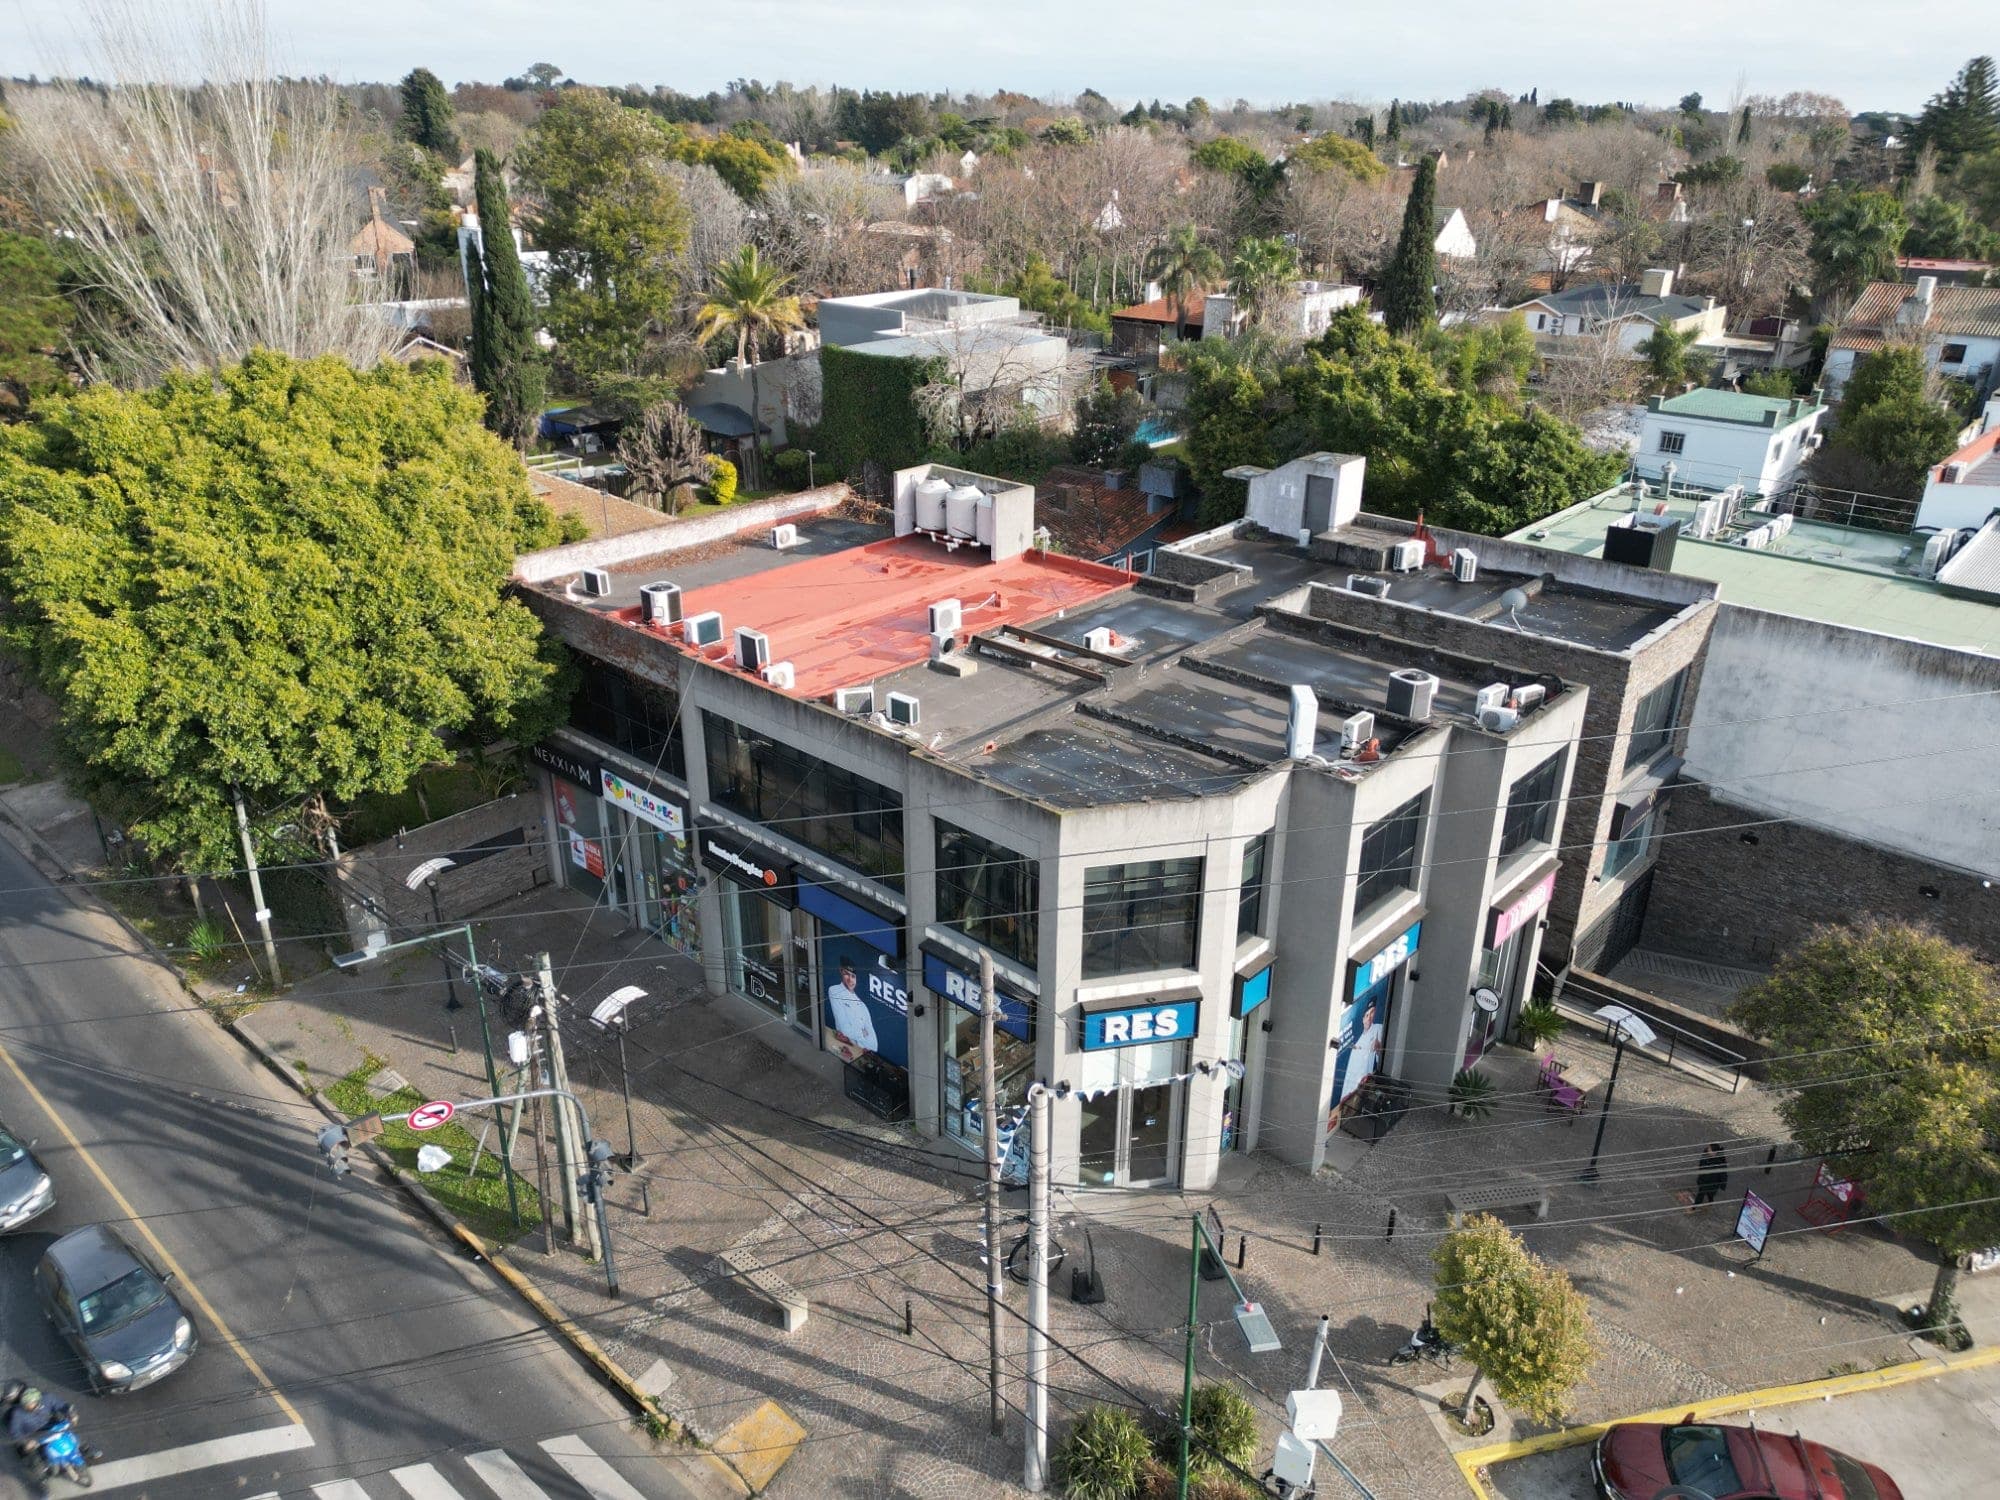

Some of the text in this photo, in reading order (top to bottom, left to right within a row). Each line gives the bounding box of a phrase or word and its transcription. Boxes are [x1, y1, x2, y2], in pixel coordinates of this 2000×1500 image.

[626, 788, 655, 811] NEURO
[869, 973, 909, 1011] RES
[1104, 1009, 1179, 1044] RES
